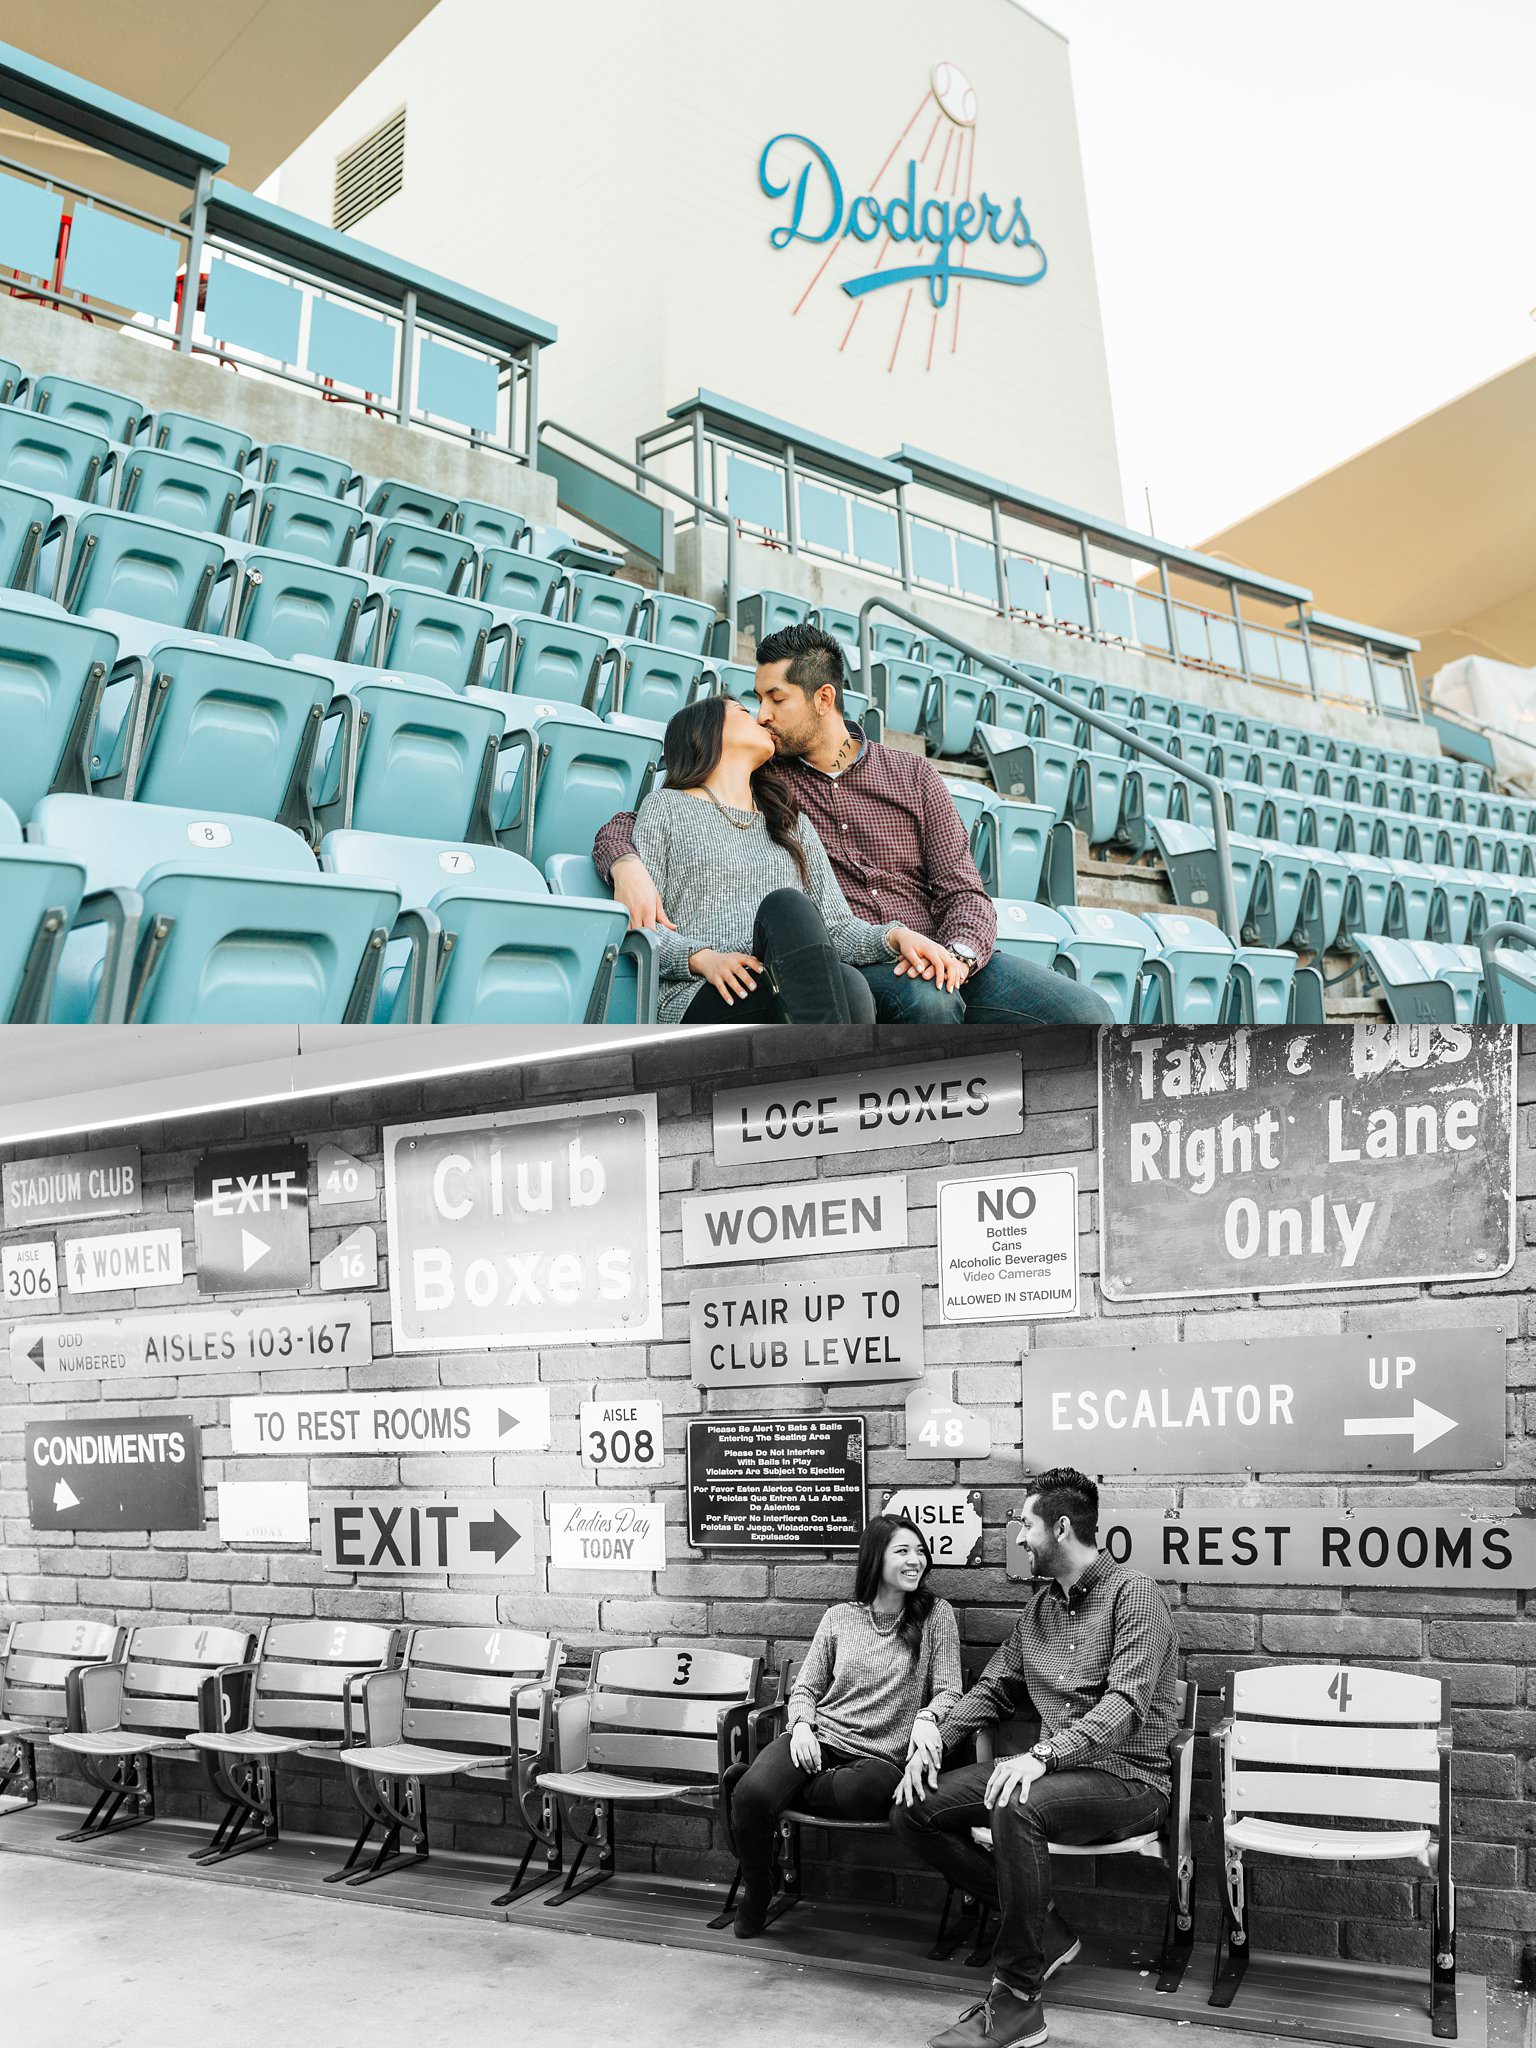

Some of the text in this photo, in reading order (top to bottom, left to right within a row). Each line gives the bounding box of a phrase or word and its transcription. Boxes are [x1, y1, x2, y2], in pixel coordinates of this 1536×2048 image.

[759, 133, 1048, 309] Dodgers
[204, 827, 214, 841] 8
[450, 856, 460, 868] 7
[1132, 1029, 1249, 1100] Taxi
[1353, 1024, 1473, 1076] Bus
[741, 1077, 990, 1144] LOGE BOXES
[1130, 1099, 1480, 1196] Right Lane
[11, 1166, 135, 1209] STADIUM CLUB
[211, 1171, 296, 1217] EXIT
[326, 1167, 359, 1194] 40
[433, 1137, 607, 1221] Club
[704, 1195, 883, 1247] WOMEN
[977, 1186, 1037, 1223] NO
[986, 1226, 1028, 1238] Bottles
[992, 1241, 1022, 1252] Cans
[1225, 1194, 1377, 1267] Only
[17, 1250, 39, 1262] AISLE
[93, 1243, 171, 1278] WOMEN
[340, 1253, 365, 1279] 16
[949, 1252, 1068, 1270] Alcoholic Beverages
[9, 1268, 52, 1296] 306
[413, 1246, 634, 1312] Boxes
[963, 1268, 1052, 1282] Video Cameras
[703, 1290, 901, 1330] STAIR UP TO
[947, 1289, 1072, 1307] ALLOWED IN STADIUM
[58, 1334, 83, 1349] ODD
[145, 1323, 351, 1364] AISLES 103-167
[710, 1336, 901, 1371] CLUB LEVEL
[59, 1354, 126, 1373] NUMBERED
[1368, 1356, 1417, 1390] UP
[254, 1406, 471, 1442] TO REST ROOMS
[603, 1408, 638, 1422] AISLE
[1051, 1384, 1295, 1432] ESCALATOR
[33, 1432, 186, 1467] CONDIMENTS
[588, 1429, 655, 1464] 308
[719, 1435, 753, 1443] Entering
[774, 1434, 806, 1442] Seating
[918, 1418, 965, 1448] 48
[763, 1468, 795, 1476] Subject
[810, 1467, 845, 1475] Ejection
[793, 1458, 811, 1466] Play
[563, 1506, 651, 1539] Ladies Day
[747, 1524, 774, 1532] Juego,
[901, 1505, 965, 1524] AISLE
[334, 1507, 459, 1567] EXIT
[580, 1538, 635, 1560] TODAY
[1094, 1525, 1514, 1570] O REST ROOMS
[71, 1624, 86, 1652] 3
[193, 1629, 209, 1658] 4
[328, 1625, 348, 1657] 3
[483, 1632, 501, 1664] 4
[672, 1652, 693, 1686] 3
[1327, 1672, 1353, 1713] 4
[730, 1725, 742, 1764] C
